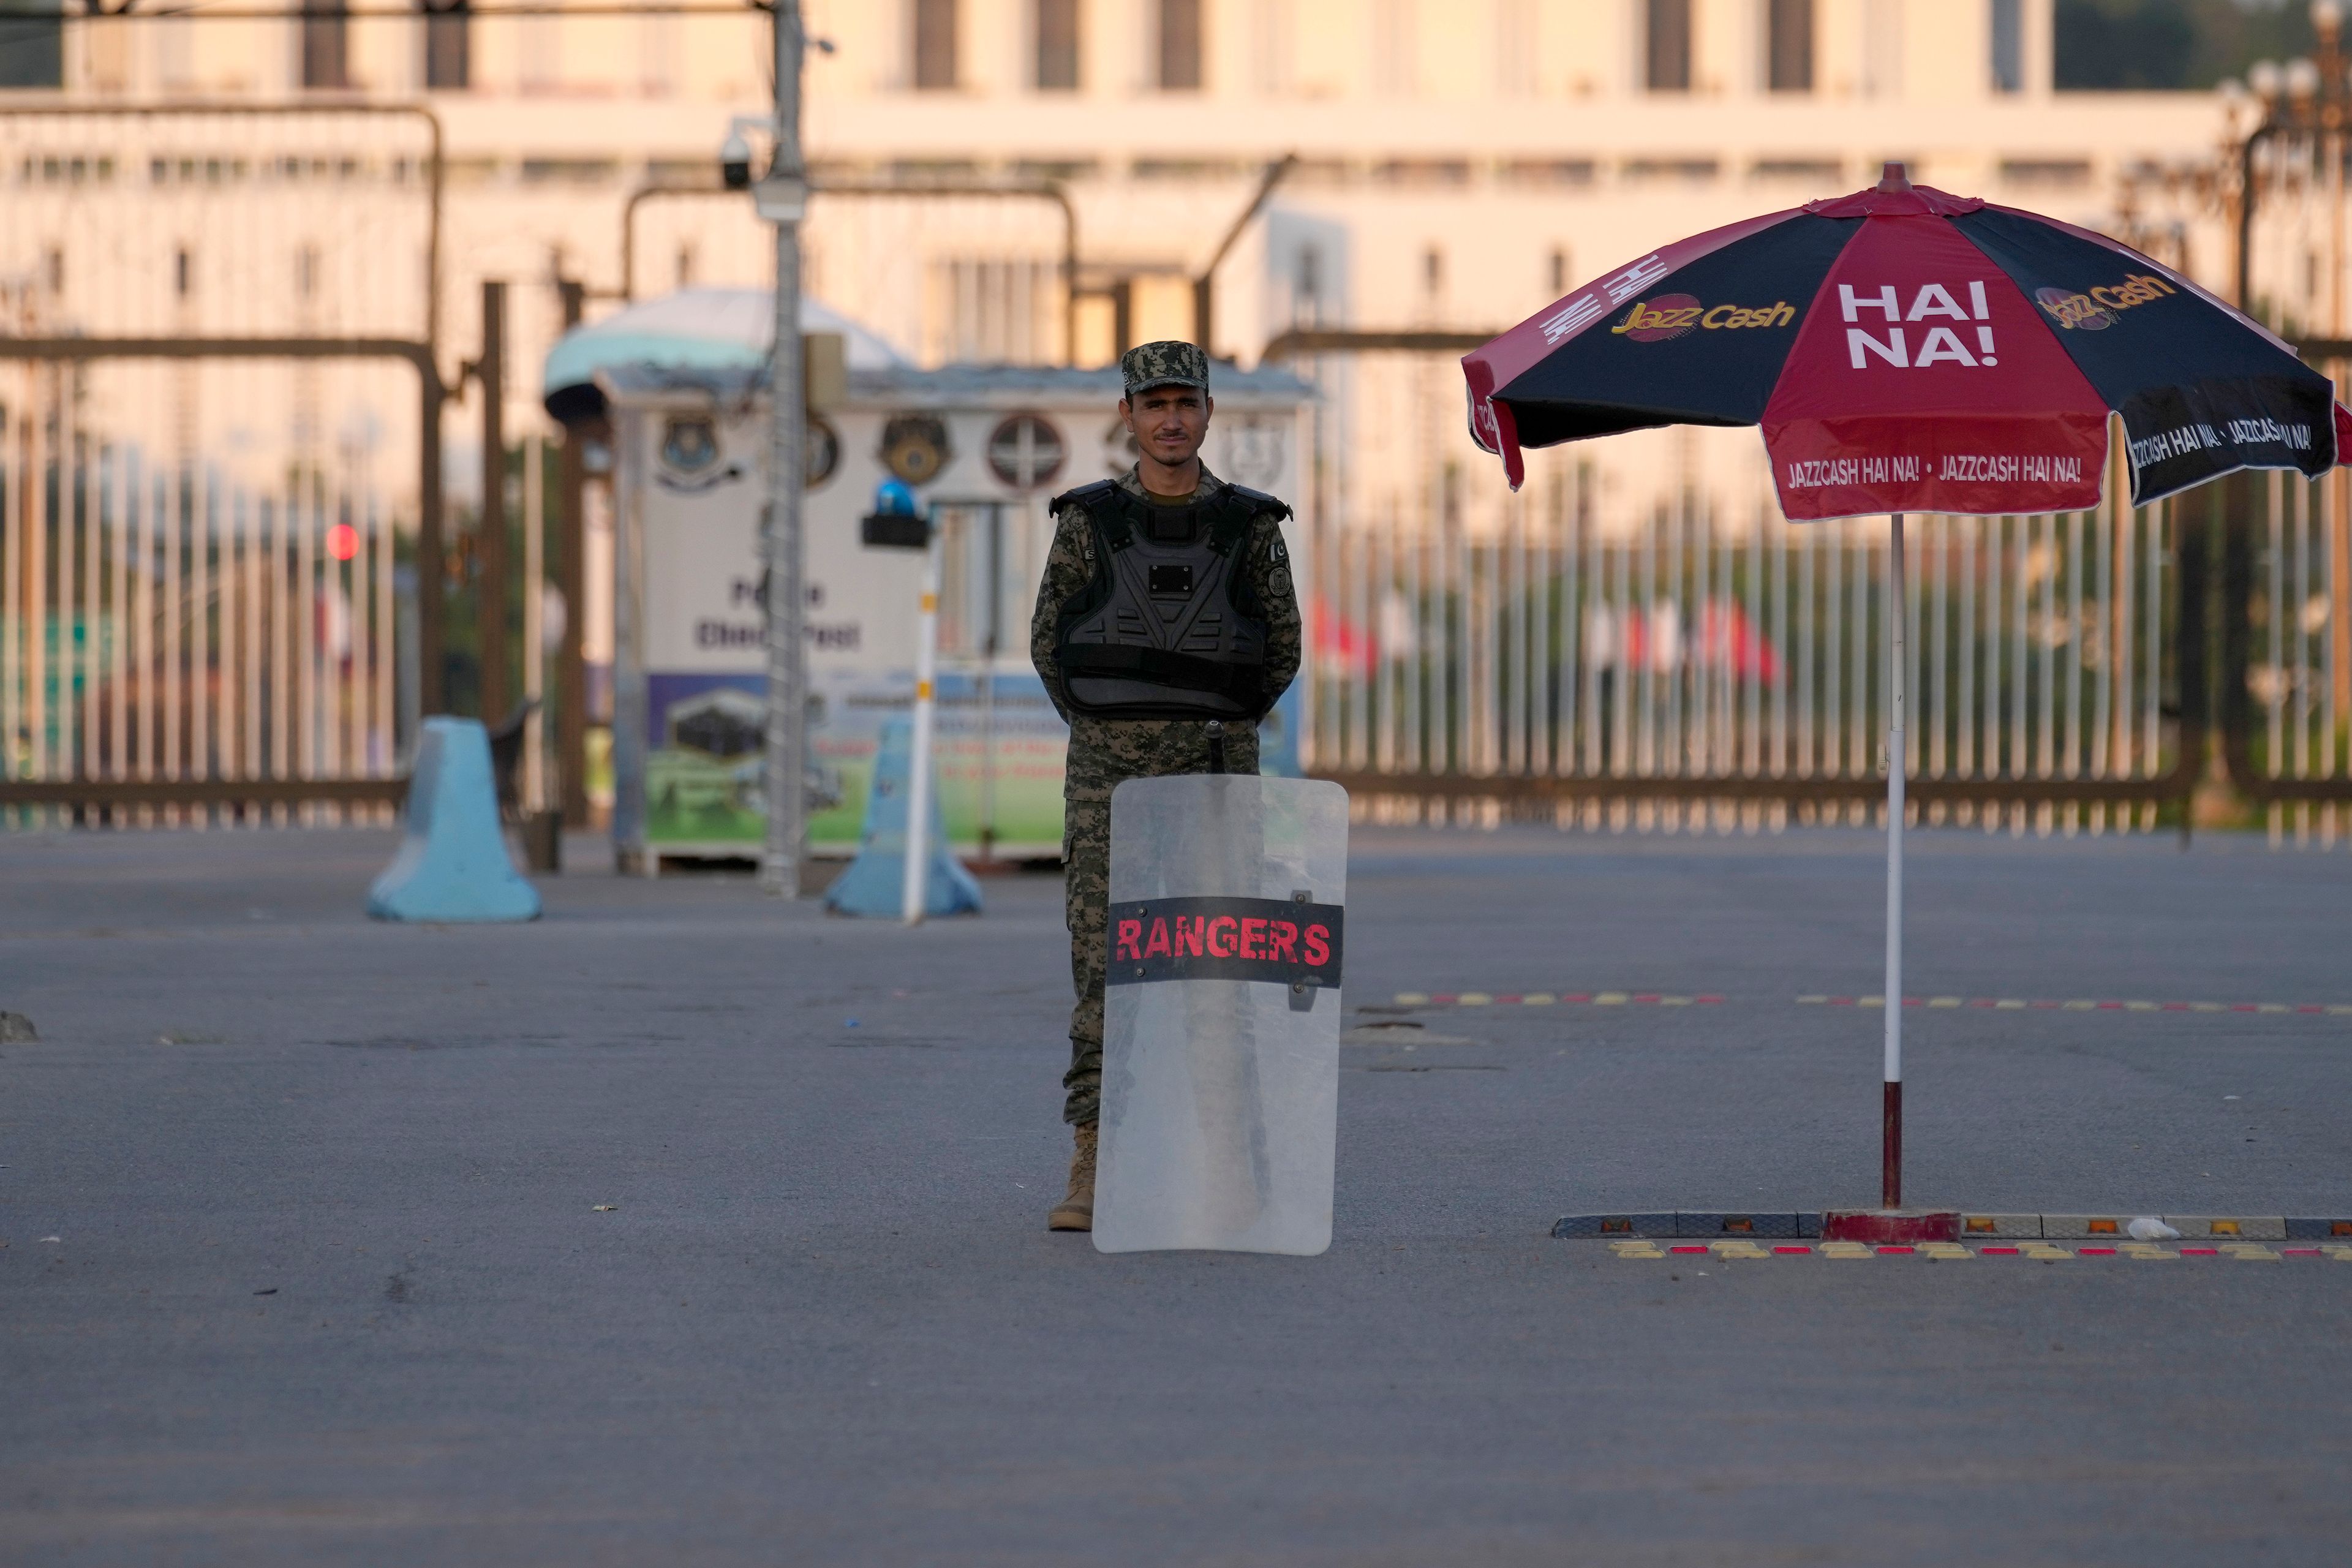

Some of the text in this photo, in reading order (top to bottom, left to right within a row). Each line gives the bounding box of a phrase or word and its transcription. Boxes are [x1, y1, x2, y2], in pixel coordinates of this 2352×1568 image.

[1838, 281, 1990, 322] HAI
[1846, 326, 1998, 369] NA!
[2132, 433, 2173, 469] ZZCASH
[2168, 424, 2201, 456] HAI
[2196, 423, 2223, 448] NA!
[2228, 417, 2282, 445] JAZZCAS
[2291, 424, 2312, 450] NA!
[1789, 456, 2081, 489] JAZZCASH HAI NA! JAZZCASH HAI NA!
[1117, 916, 1330, 966] RANGERS
